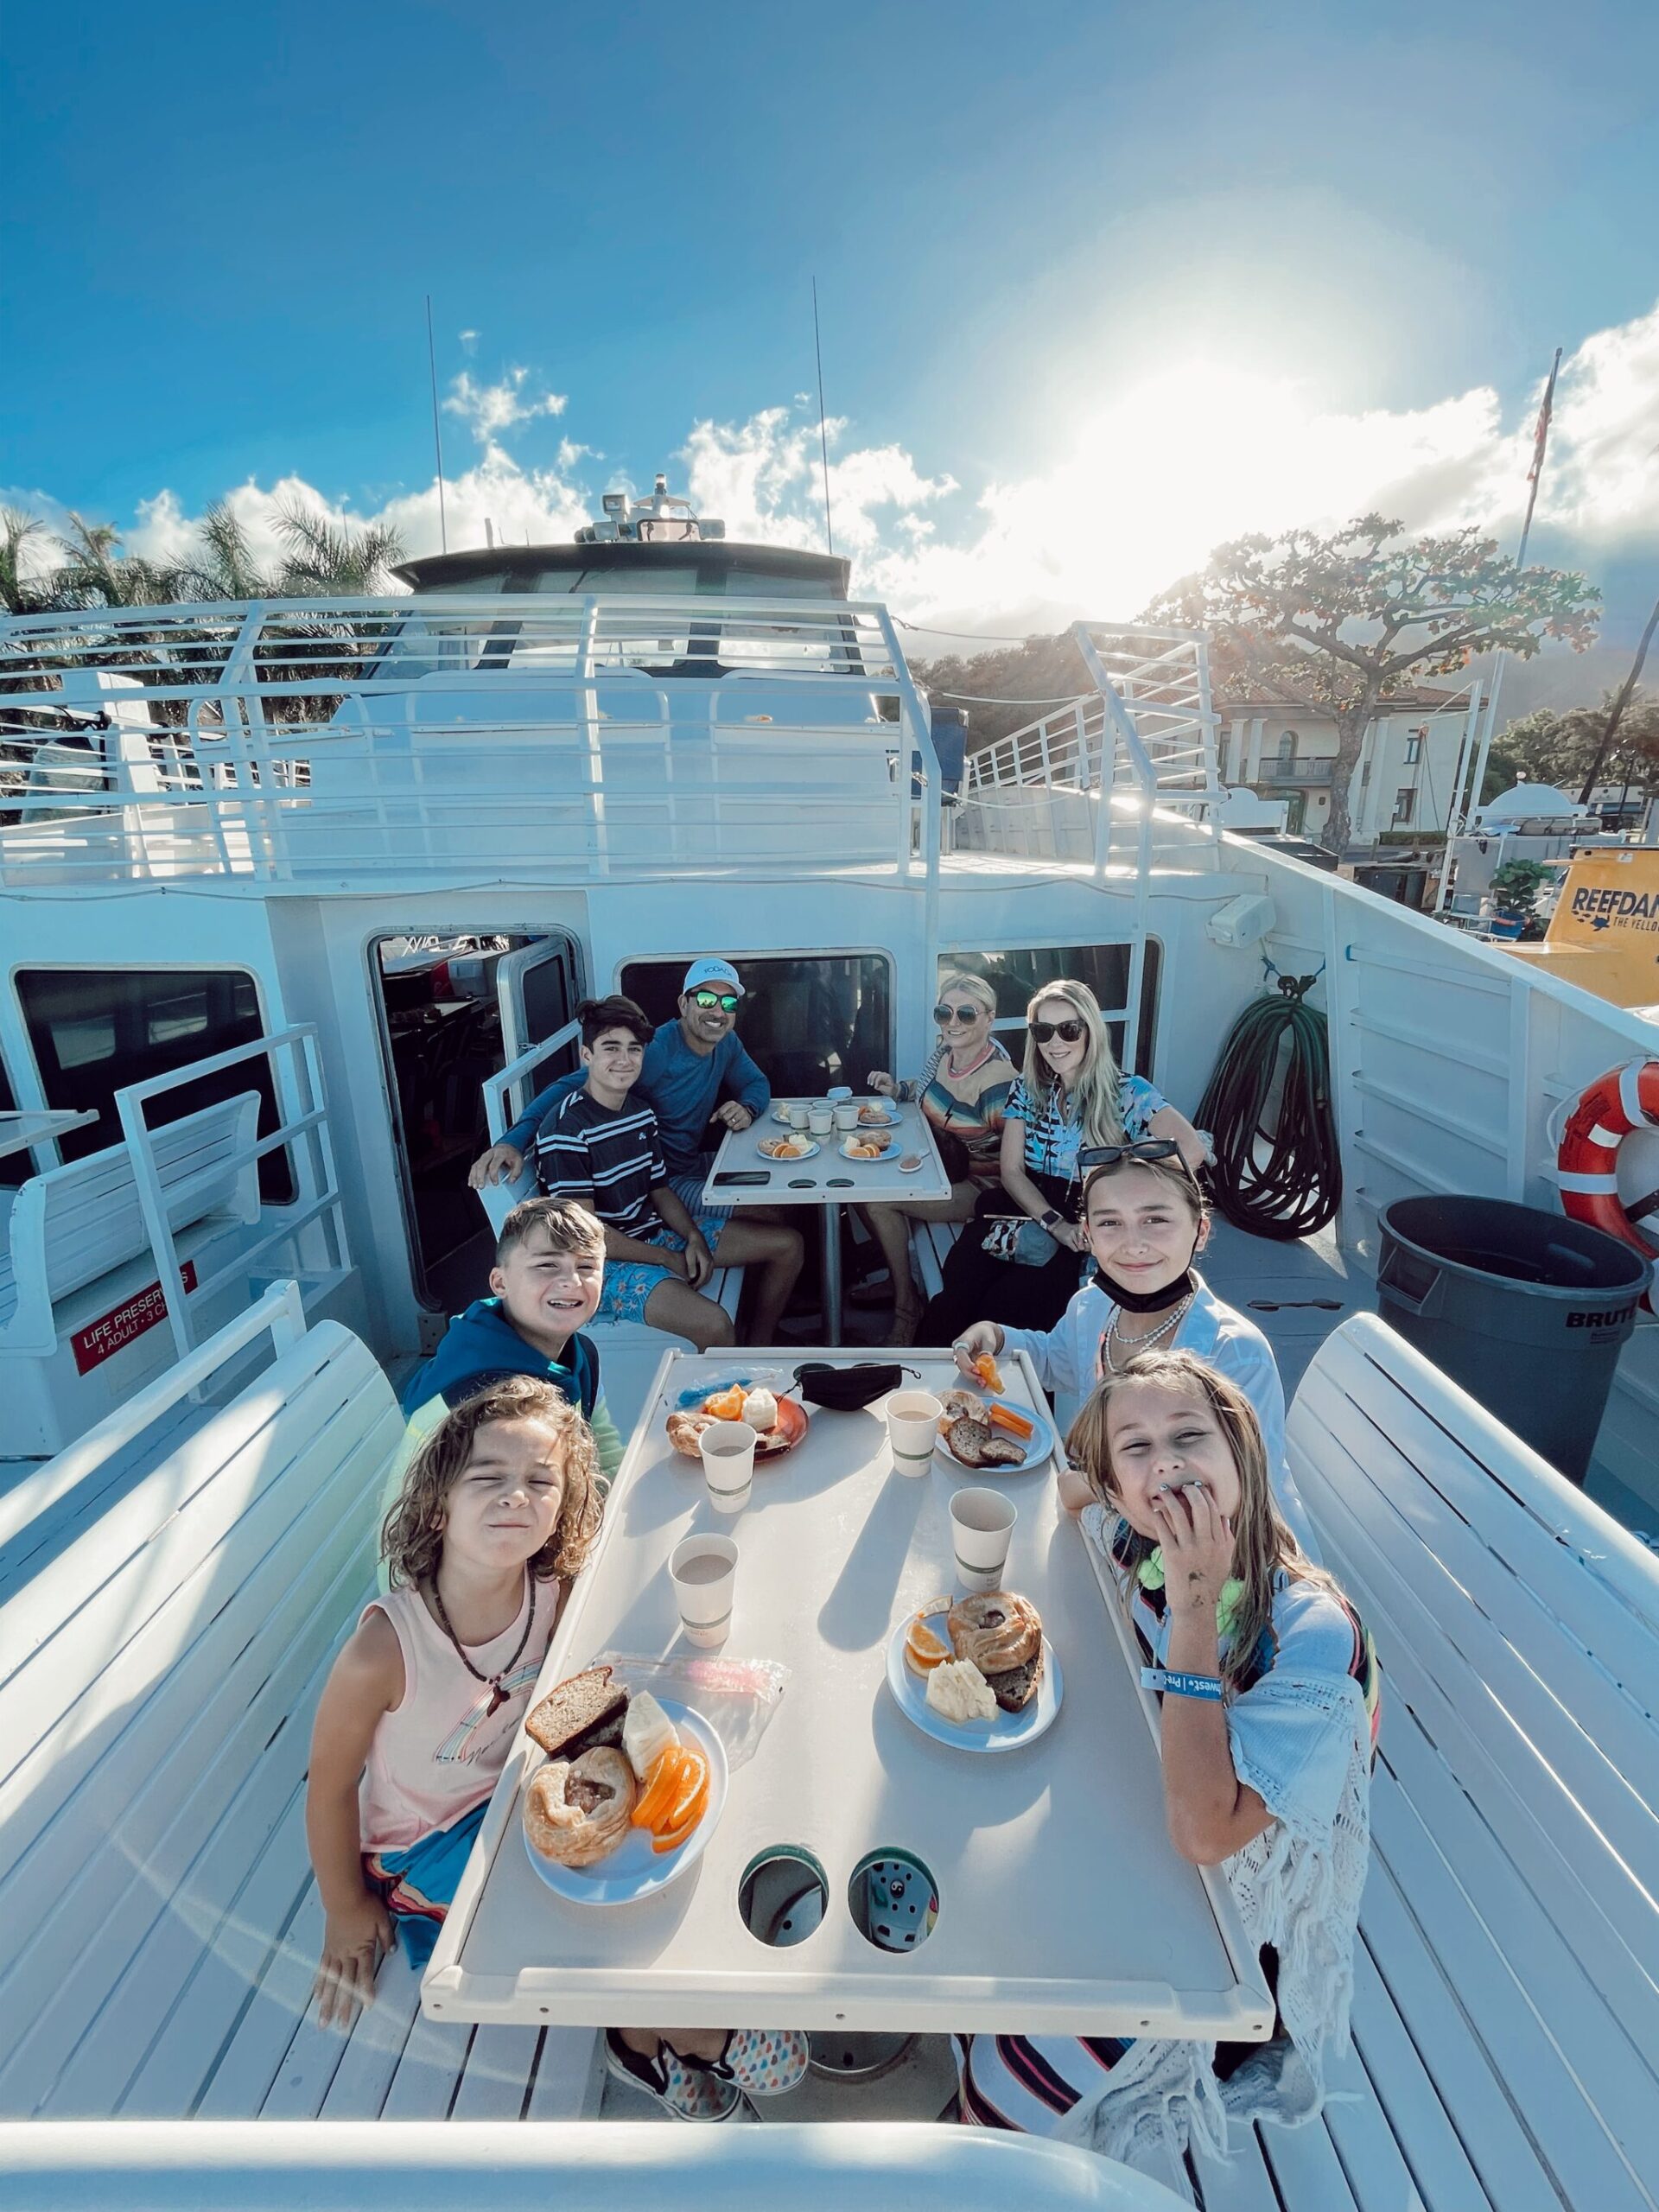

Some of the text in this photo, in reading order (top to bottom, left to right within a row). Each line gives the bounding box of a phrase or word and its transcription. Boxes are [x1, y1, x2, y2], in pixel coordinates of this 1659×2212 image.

[1613, 916, 1659, 932] THE YELLO
[84, 1321, 113, 1349] LIFE
[98, 1344, 105, 1355] 4
[107, 1319, 142, 1351] ADULT
[147, 1310, 154, 1321] 3
